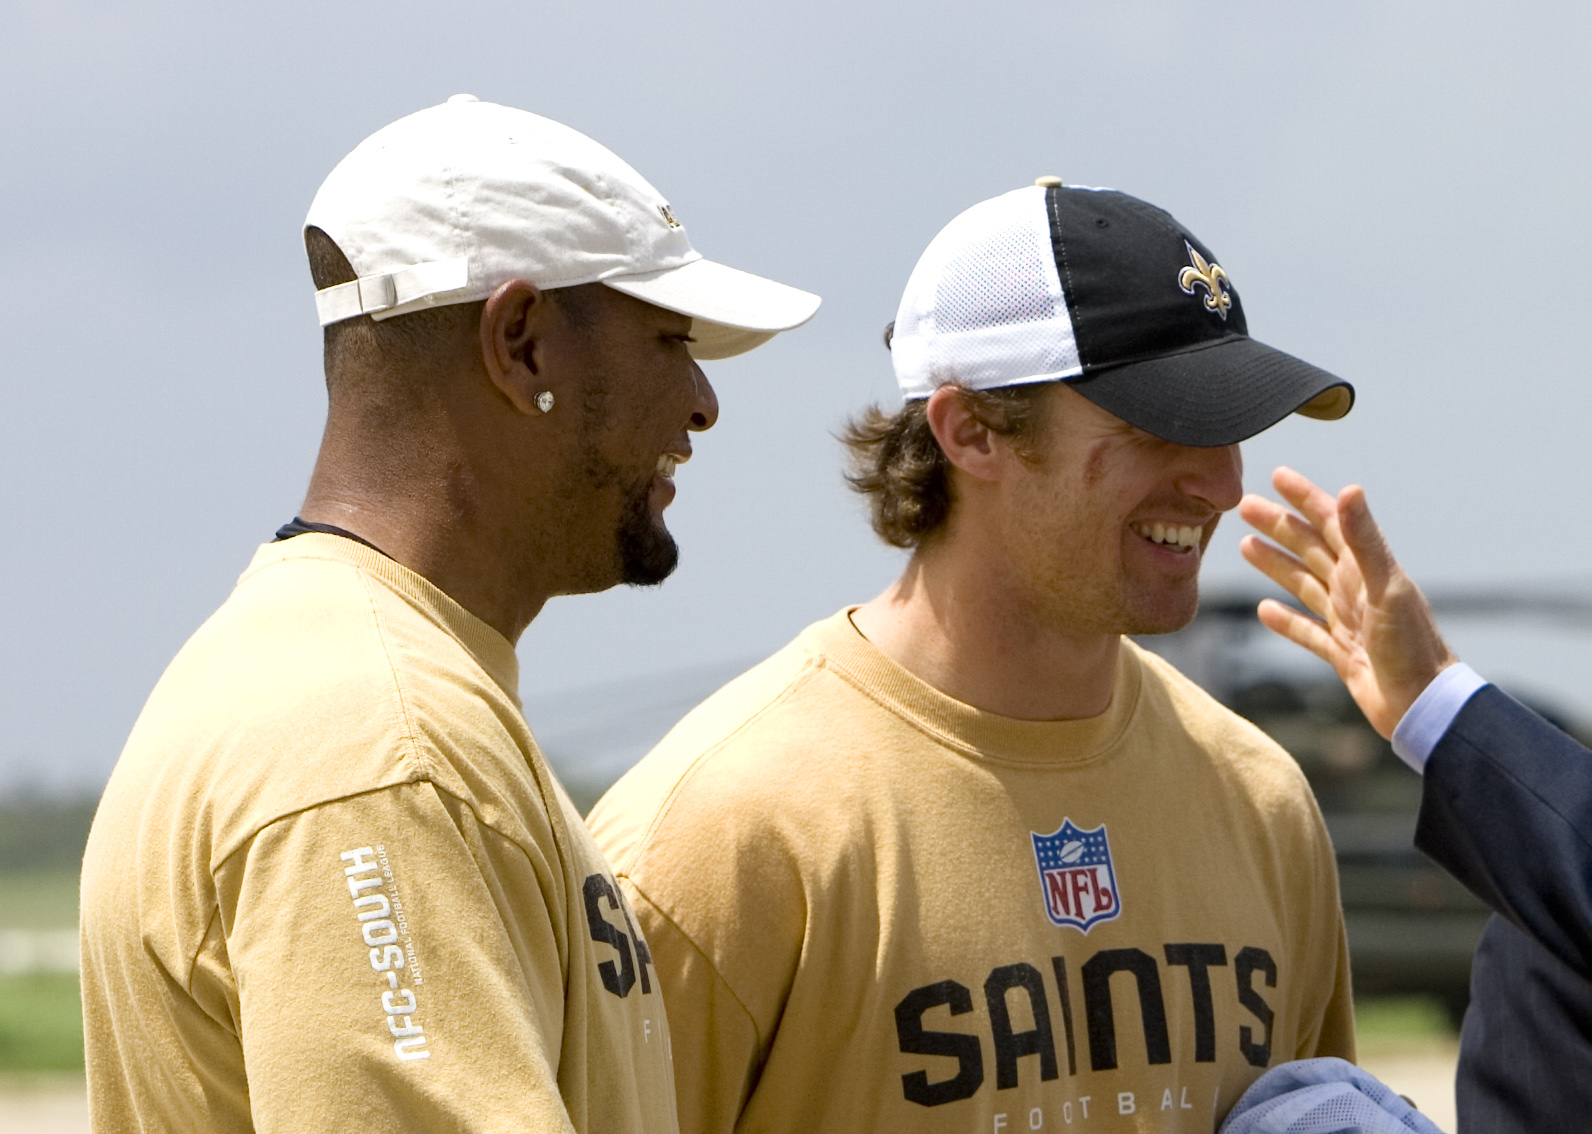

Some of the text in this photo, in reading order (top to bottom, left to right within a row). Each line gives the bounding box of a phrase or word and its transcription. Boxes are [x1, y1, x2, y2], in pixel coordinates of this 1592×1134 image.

[340, 846, 431, 1061] NFC-SOUTH
[376, 844, 424, 986] NATIONAL FOOTBALL LEAGUE
[1045, 867, 1113, 921] NFL
[894, 943, 1278, 1108] SAINTS
